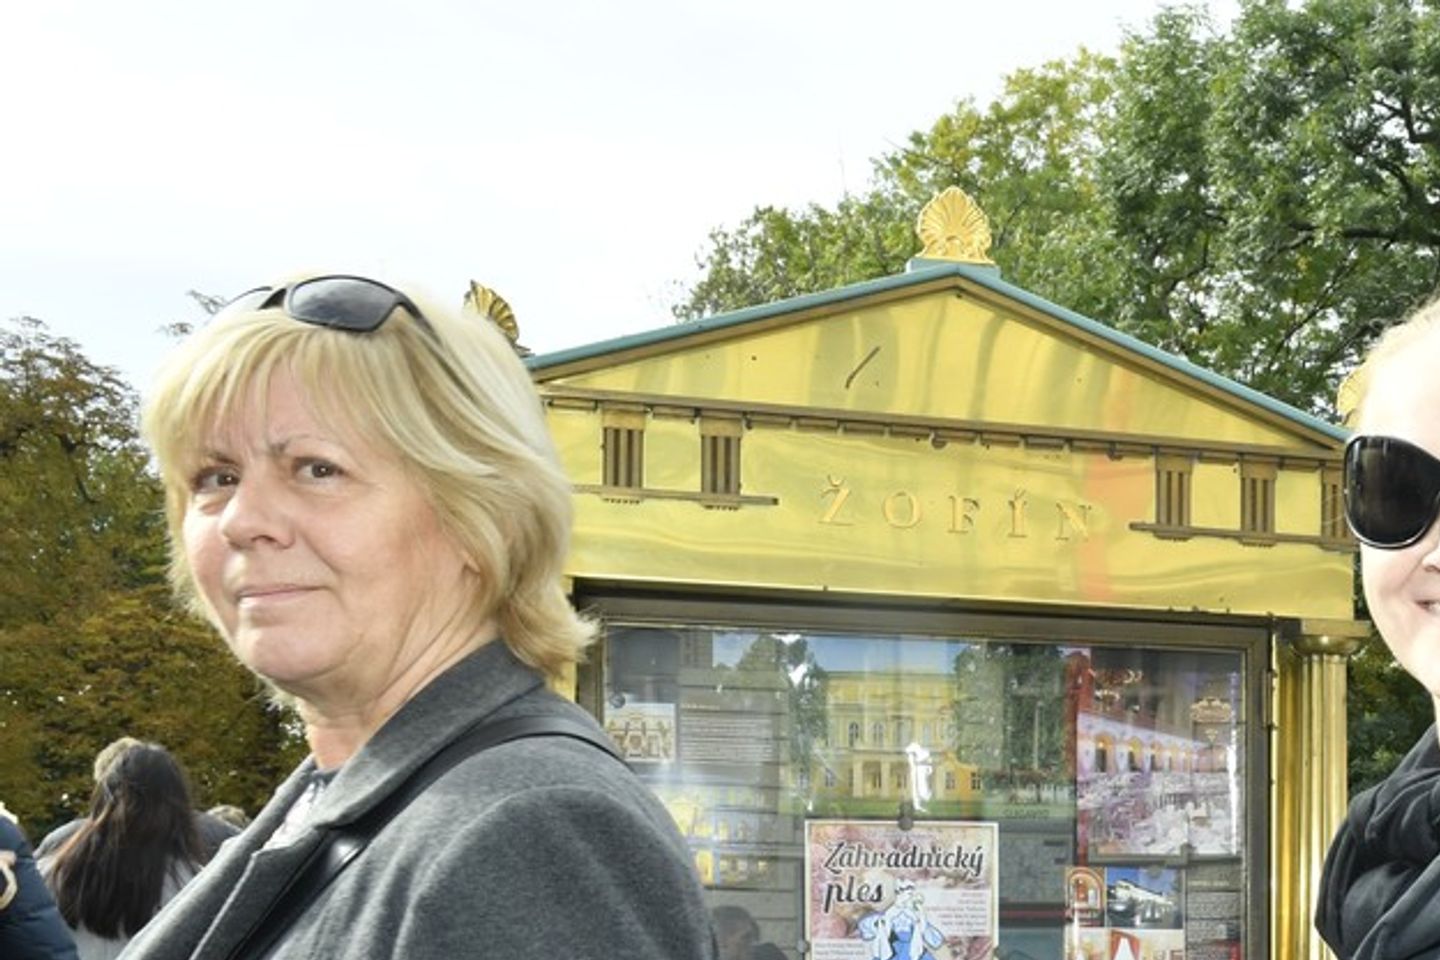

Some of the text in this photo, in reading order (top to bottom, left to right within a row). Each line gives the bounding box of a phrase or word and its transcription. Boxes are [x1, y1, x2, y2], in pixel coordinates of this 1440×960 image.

[818, 474, 1092, 541] ŽOFÍN
[823, 841, 985, 878] Zahradnický
[823, 875, 884, 914] ples
